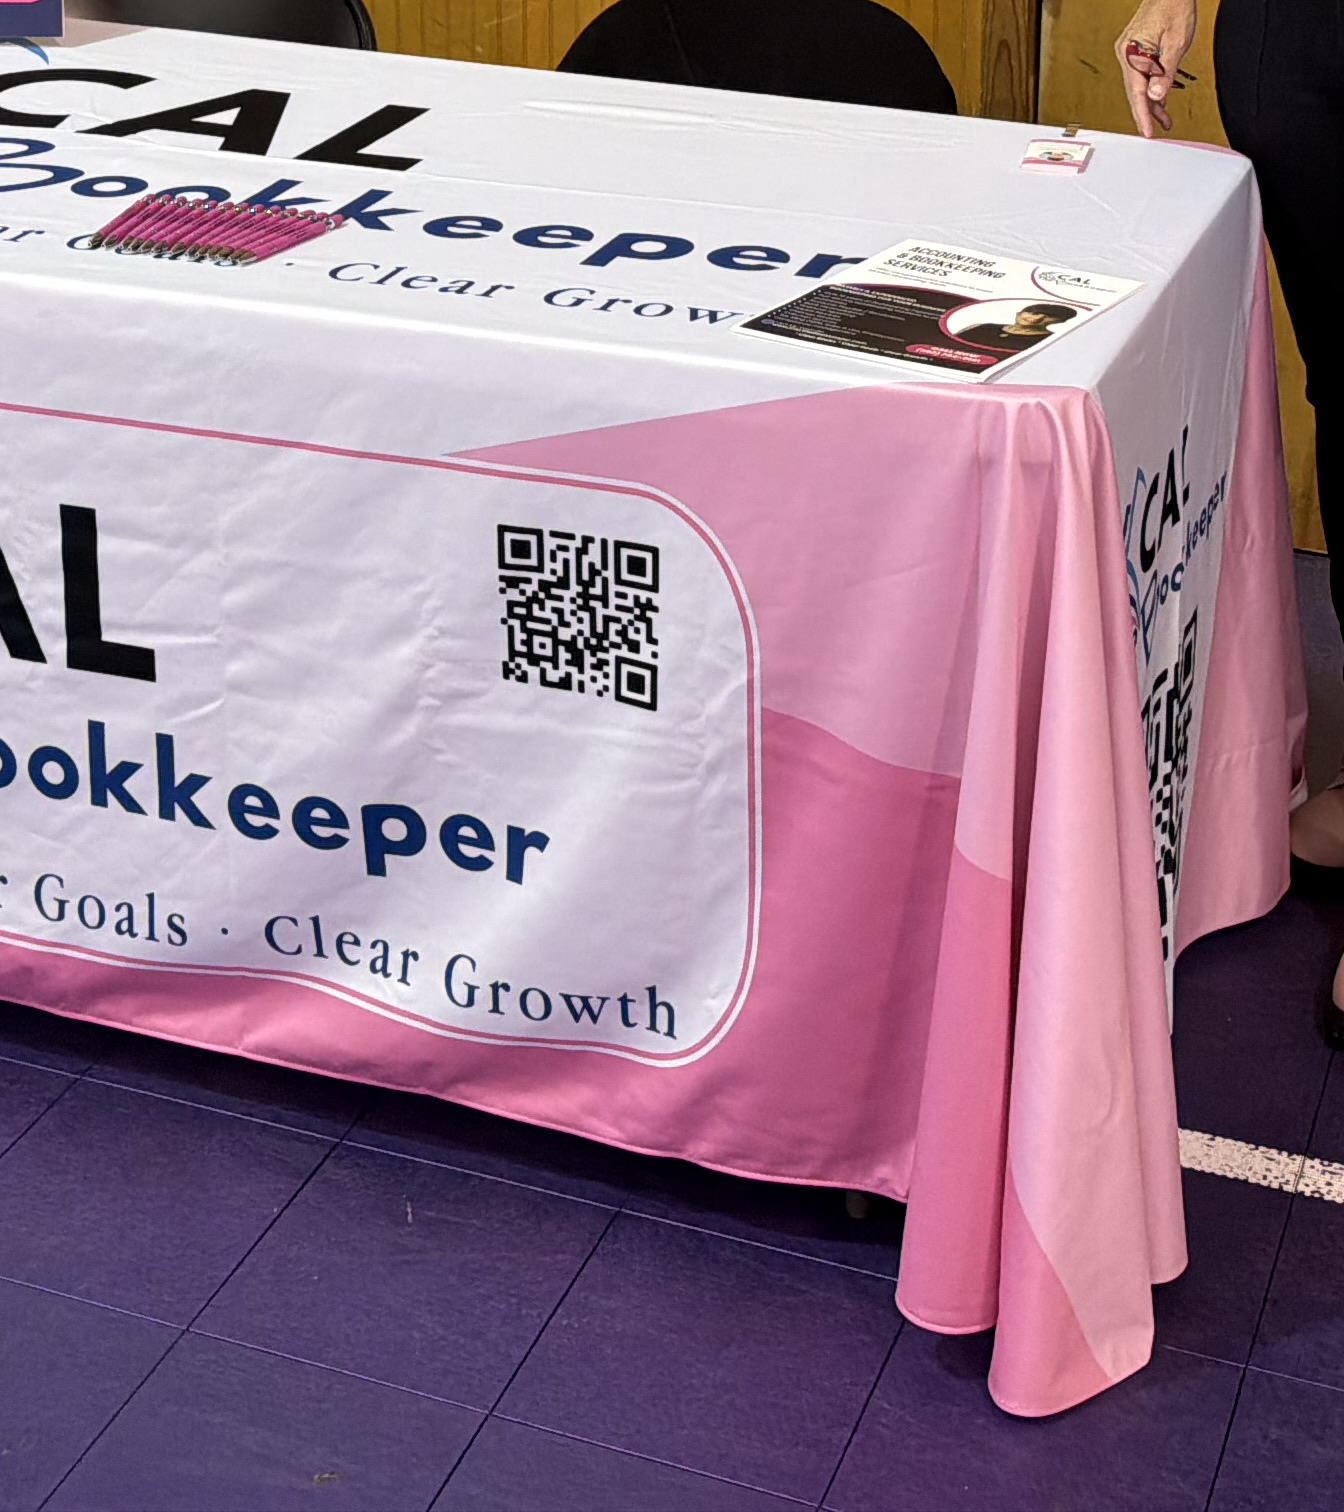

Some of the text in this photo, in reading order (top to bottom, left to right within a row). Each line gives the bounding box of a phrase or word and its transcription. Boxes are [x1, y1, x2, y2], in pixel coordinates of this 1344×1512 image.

[883, 259, 952, 276] SERVICES
[908, 246, 996, 268] ACCOUNTING
[909, 255, 1006, 279] BOOKKEEPING
[1056, 273, 1092, 285] CAL
[328, 262, 515, 299] Clear
[544, 287, 755, 324] Grow
[33, 873, 188, 948] Goals
[264, 915, 419, 986] Clear
[444, 953, 678, 1040] Growth
